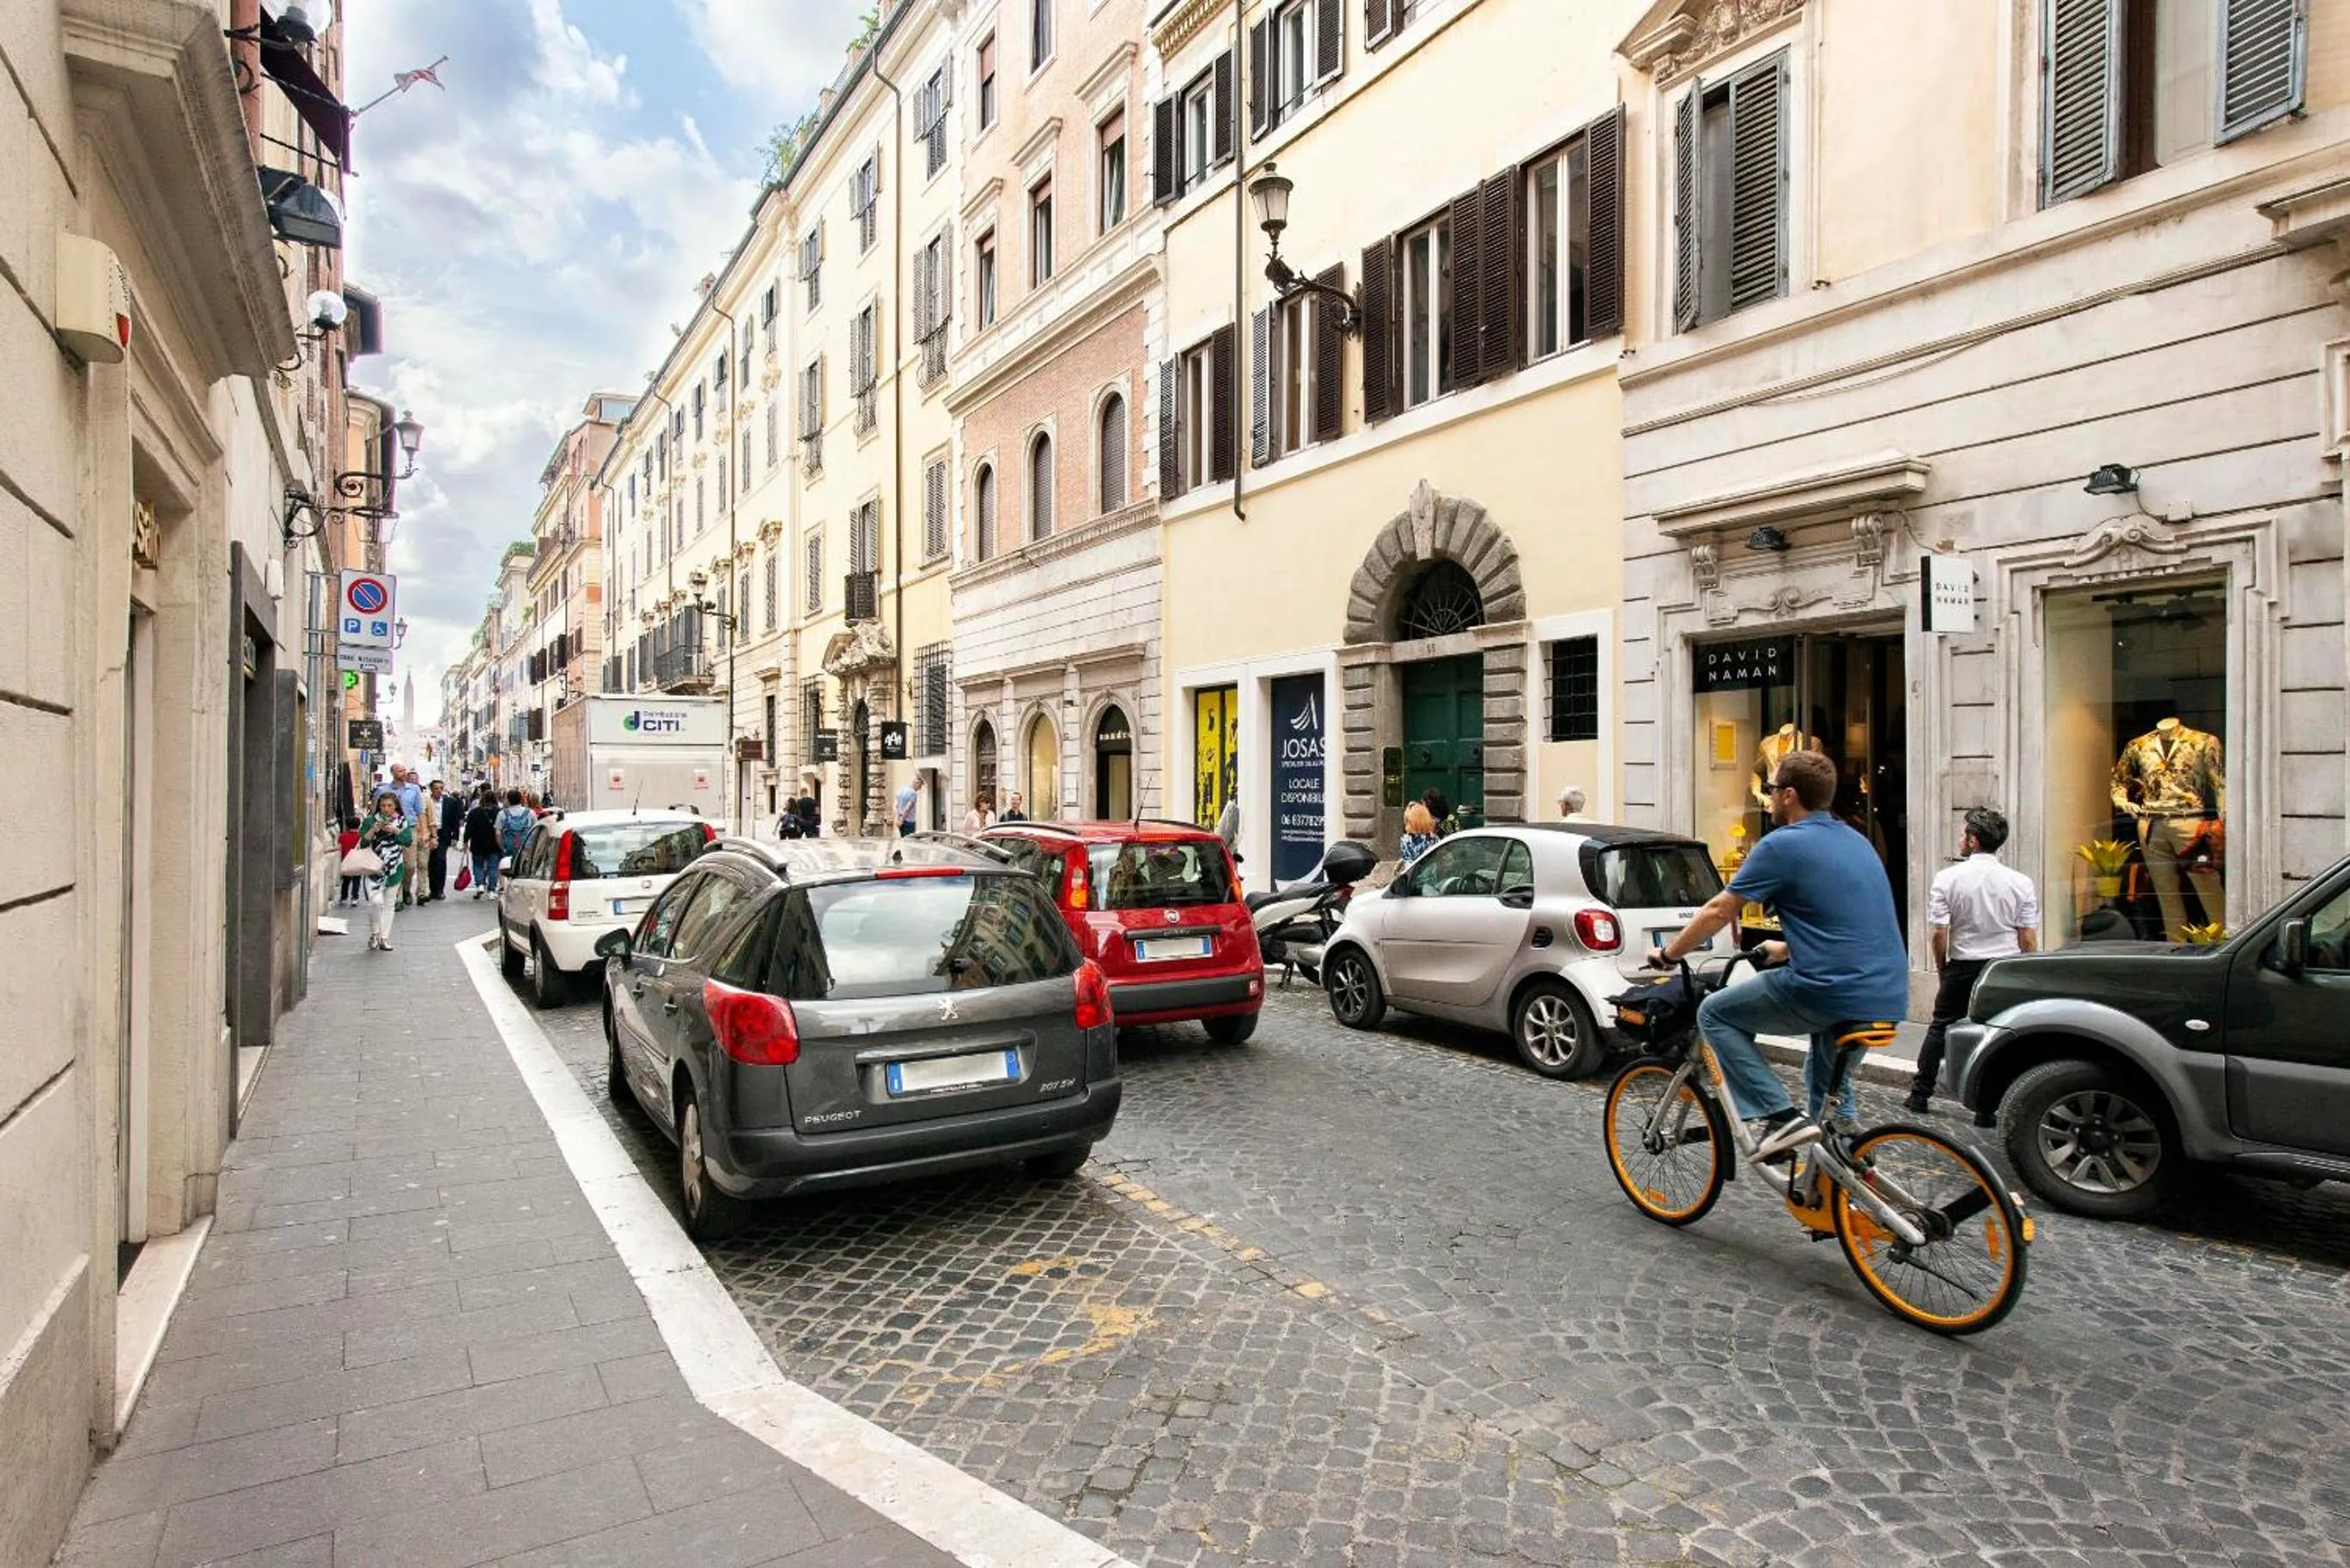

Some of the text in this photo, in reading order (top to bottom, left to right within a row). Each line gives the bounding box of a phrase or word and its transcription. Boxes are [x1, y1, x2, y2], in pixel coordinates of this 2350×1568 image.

[1936, 581, 1969, 593] DAVID
[1708, 647, 1777, 665] DAVID
[1708, 665, 1777, 682] NAMAN
[642, 720, 680, 732] CITI
[1281, 737, 1327, 759] JOSAS
[1288, 777, 1320, 789] LOCALE
[1281, 813, 1291, 825] 06
[804, 1109, 862, 1126] PEUGEOT
